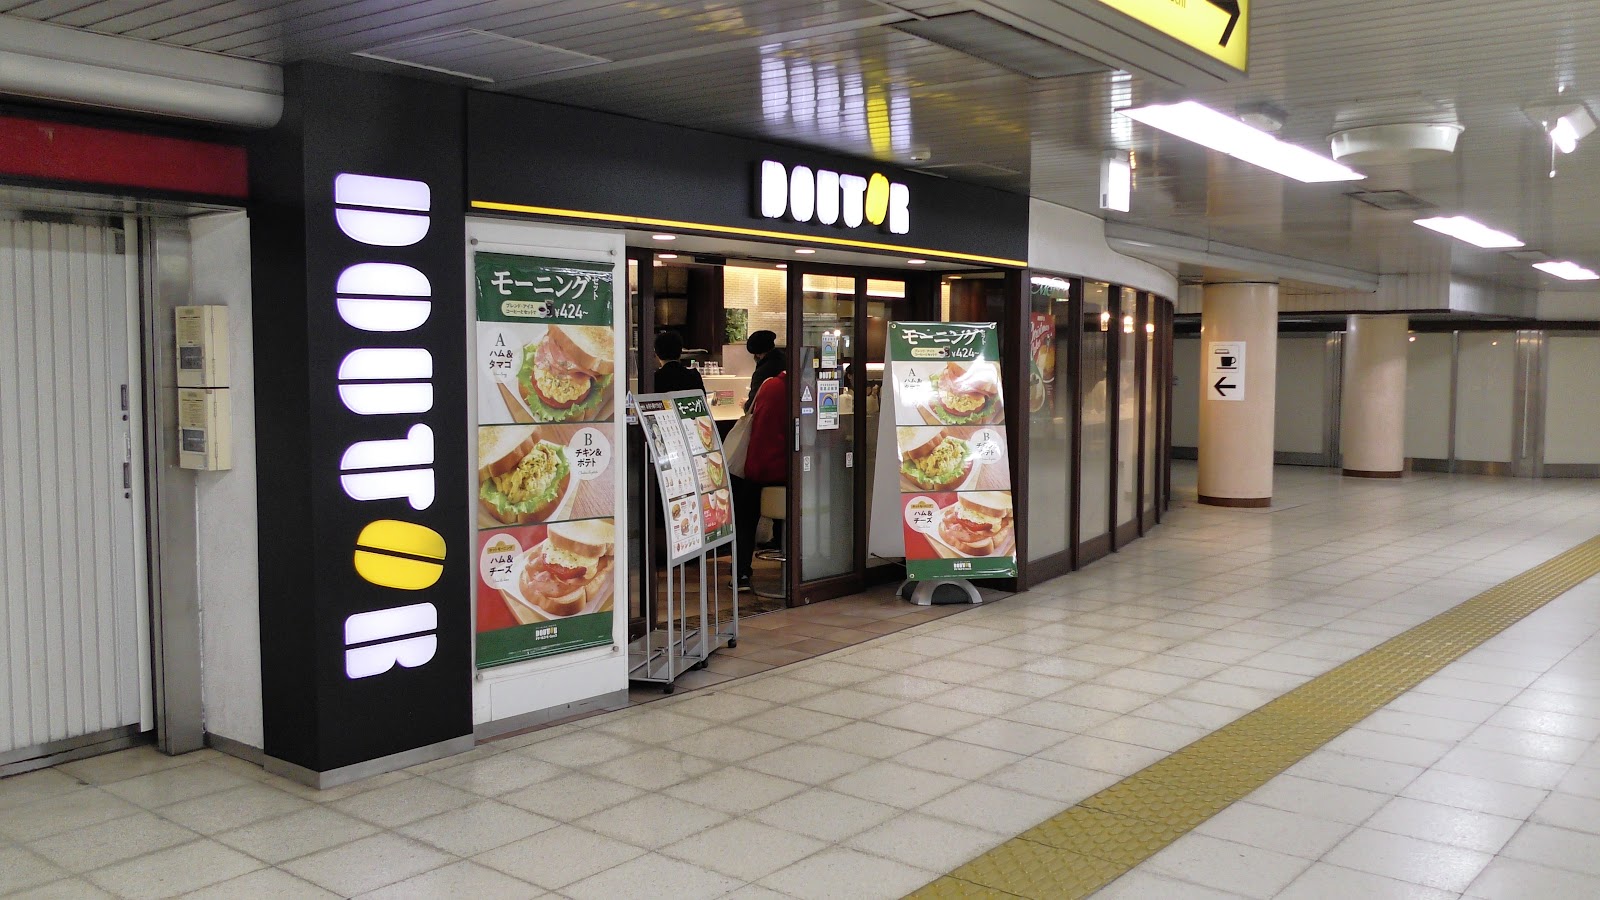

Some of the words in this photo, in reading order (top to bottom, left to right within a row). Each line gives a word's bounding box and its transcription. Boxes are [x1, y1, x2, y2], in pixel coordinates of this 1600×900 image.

[761, 159, 910, 235] DOUTOR
[490, 270, 591, 300] モーニング
[495, 333, 506, 347] A
[901, 328, 979, 346] モーニング
[489, 349, 513, 359] ハム&
[489, 359, 512, 369] タマゴ
[908, 367, 916, 377] A
[335, 172, 447, 680] DOUTOR
[584, 433, 593, 446] B
[983, 432, 990, 441] B
[575, 448, 602, 457] チキン&
[490, 554, 513, 564] ハム&
[489, 564, 513, 577] チーズ
